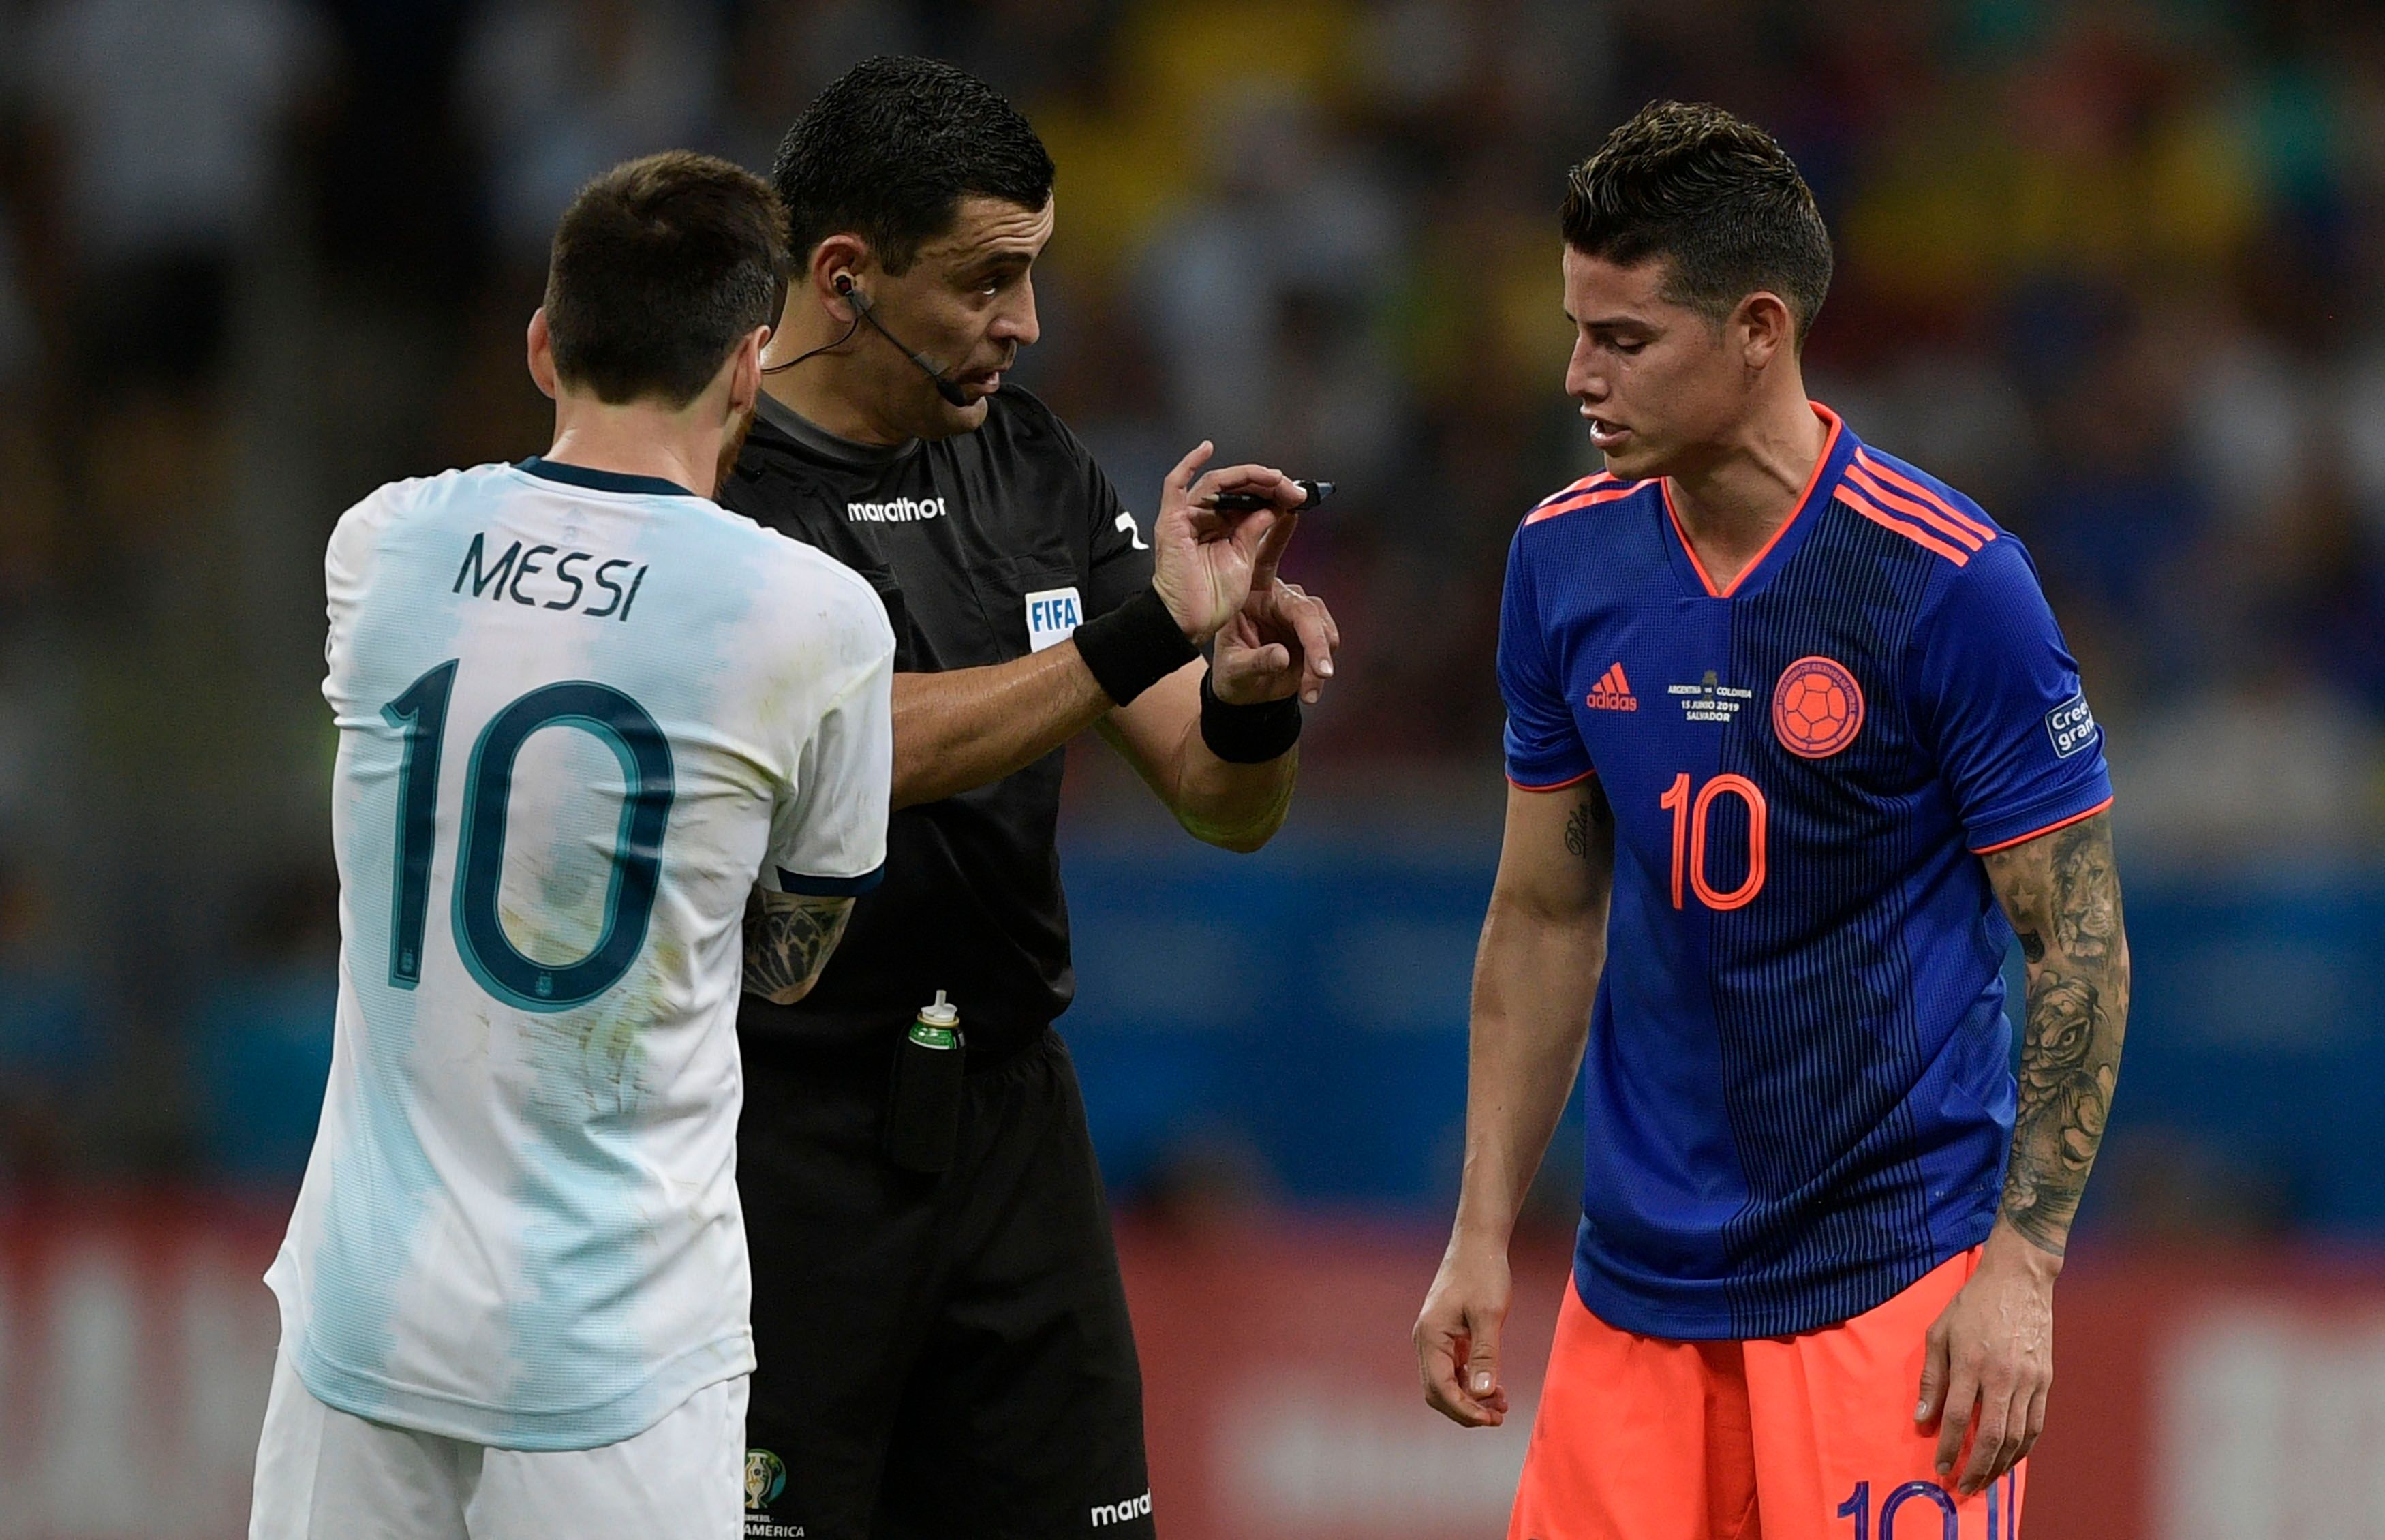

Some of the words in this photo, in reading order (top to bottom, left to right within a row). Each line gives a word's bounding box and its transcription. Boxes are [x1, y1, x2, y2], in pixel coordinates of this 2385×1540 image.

[452, 532, 649, 622] MESSI
[1032, 598, 1077, 632] FIFA
[1586, 691, 1637, 711] adidas
[1681, 700, 1690, 709] 15
[1691, 700, 1715, 709] JUNIO
[1717, 701, 1740, 711] 2019
[1686, 711, 1731, 722] SALVADOR
[380, 658, 675, 1013] 10
[1660, 772, 1766, 910] 10
